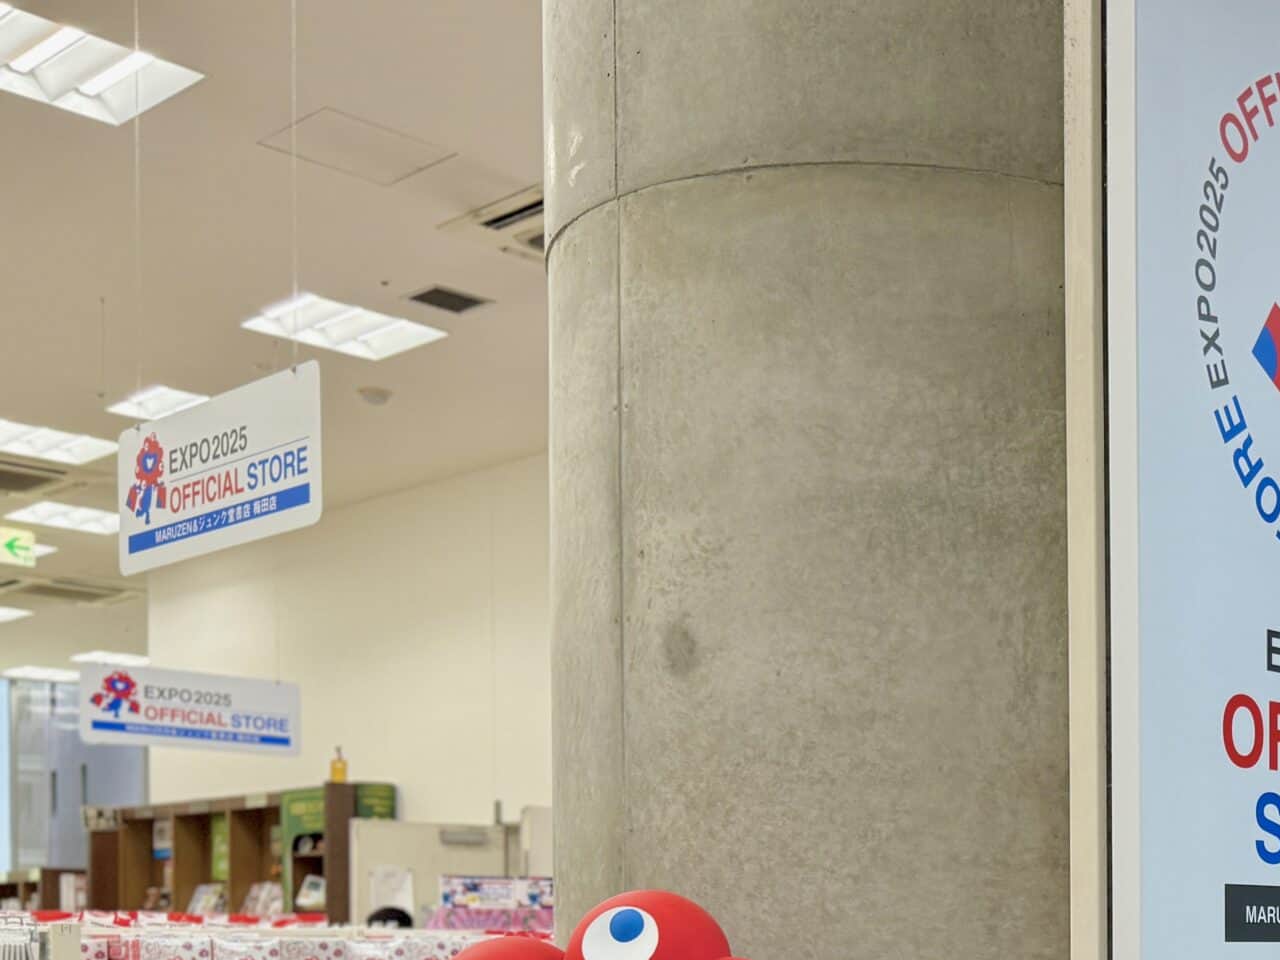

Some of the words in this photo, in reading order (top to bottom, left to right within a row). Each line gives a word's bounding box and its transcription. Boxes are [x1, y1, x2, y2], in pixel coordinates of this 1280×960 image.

[1195, 157, 1230, 390] EXPO2025
[168, 426, 248, 474] EXPO2025
[169, 468, 244, 514] OFFICIAL
[247, 446, 308, 490] STORE
[143, 684, 232, 709] EXPO2025
[143, 705, 228, 728] OFFICIAL
[230, 713, 290, 734] STORE
